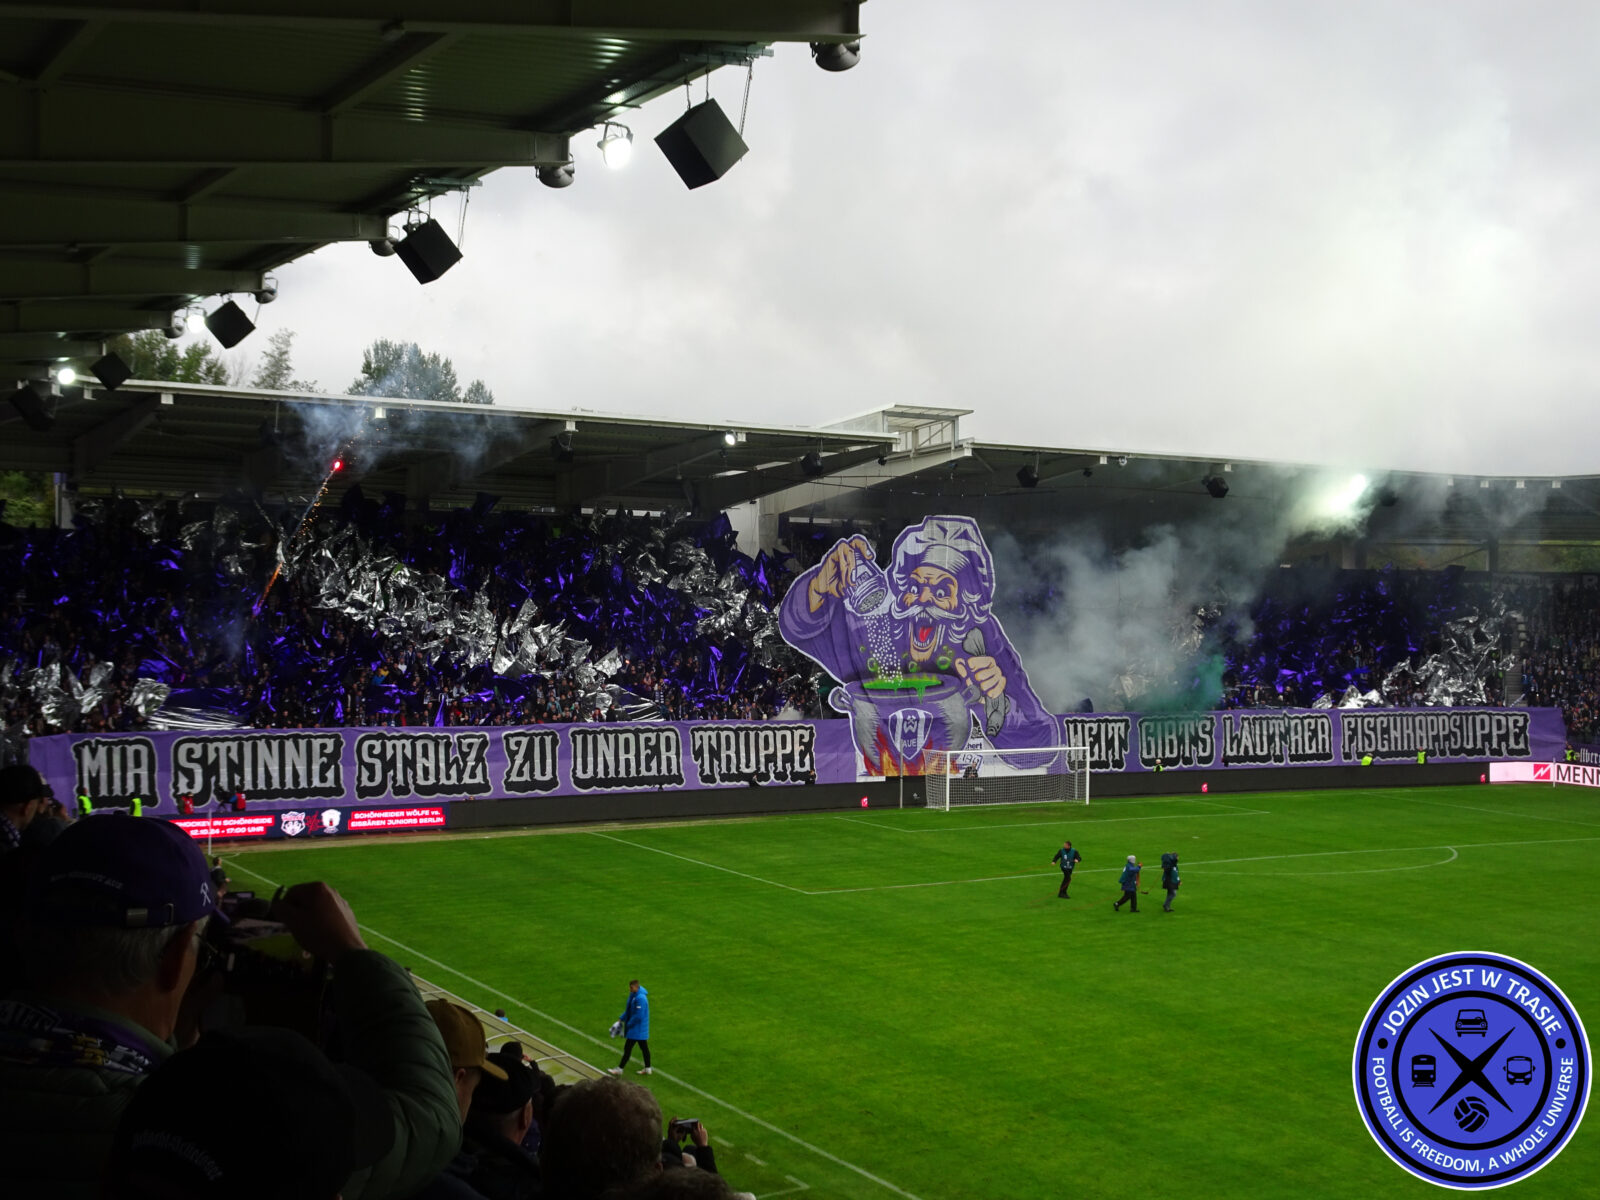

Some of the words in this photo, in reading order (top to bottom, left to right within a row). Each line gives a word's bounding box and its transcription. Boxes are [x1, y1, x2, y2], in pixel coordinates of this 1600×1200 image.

[176, 738, 337, 795] STINNE
[360, 734, 488, 788] STOLZ
[508, 732, 554, 783] ZU
[694, 728, 813, 777] TRUPPE
[354, 810, 404, 819] SCHÖNHEIDER
[406, 809, 430, 817] WÖLFE
[175, 820, 211, 828] HOCKEY
[212, 819, 222, 827] IN
[222, 817, 273, 826] SCHÖNHEIDE
[350, 818, 386, 828] EISBÄREN
[387, 817, 418, 826] JUNIORS
[226, 826, 246, 834] 17:00
[247, 825, 264, 833] UHR
